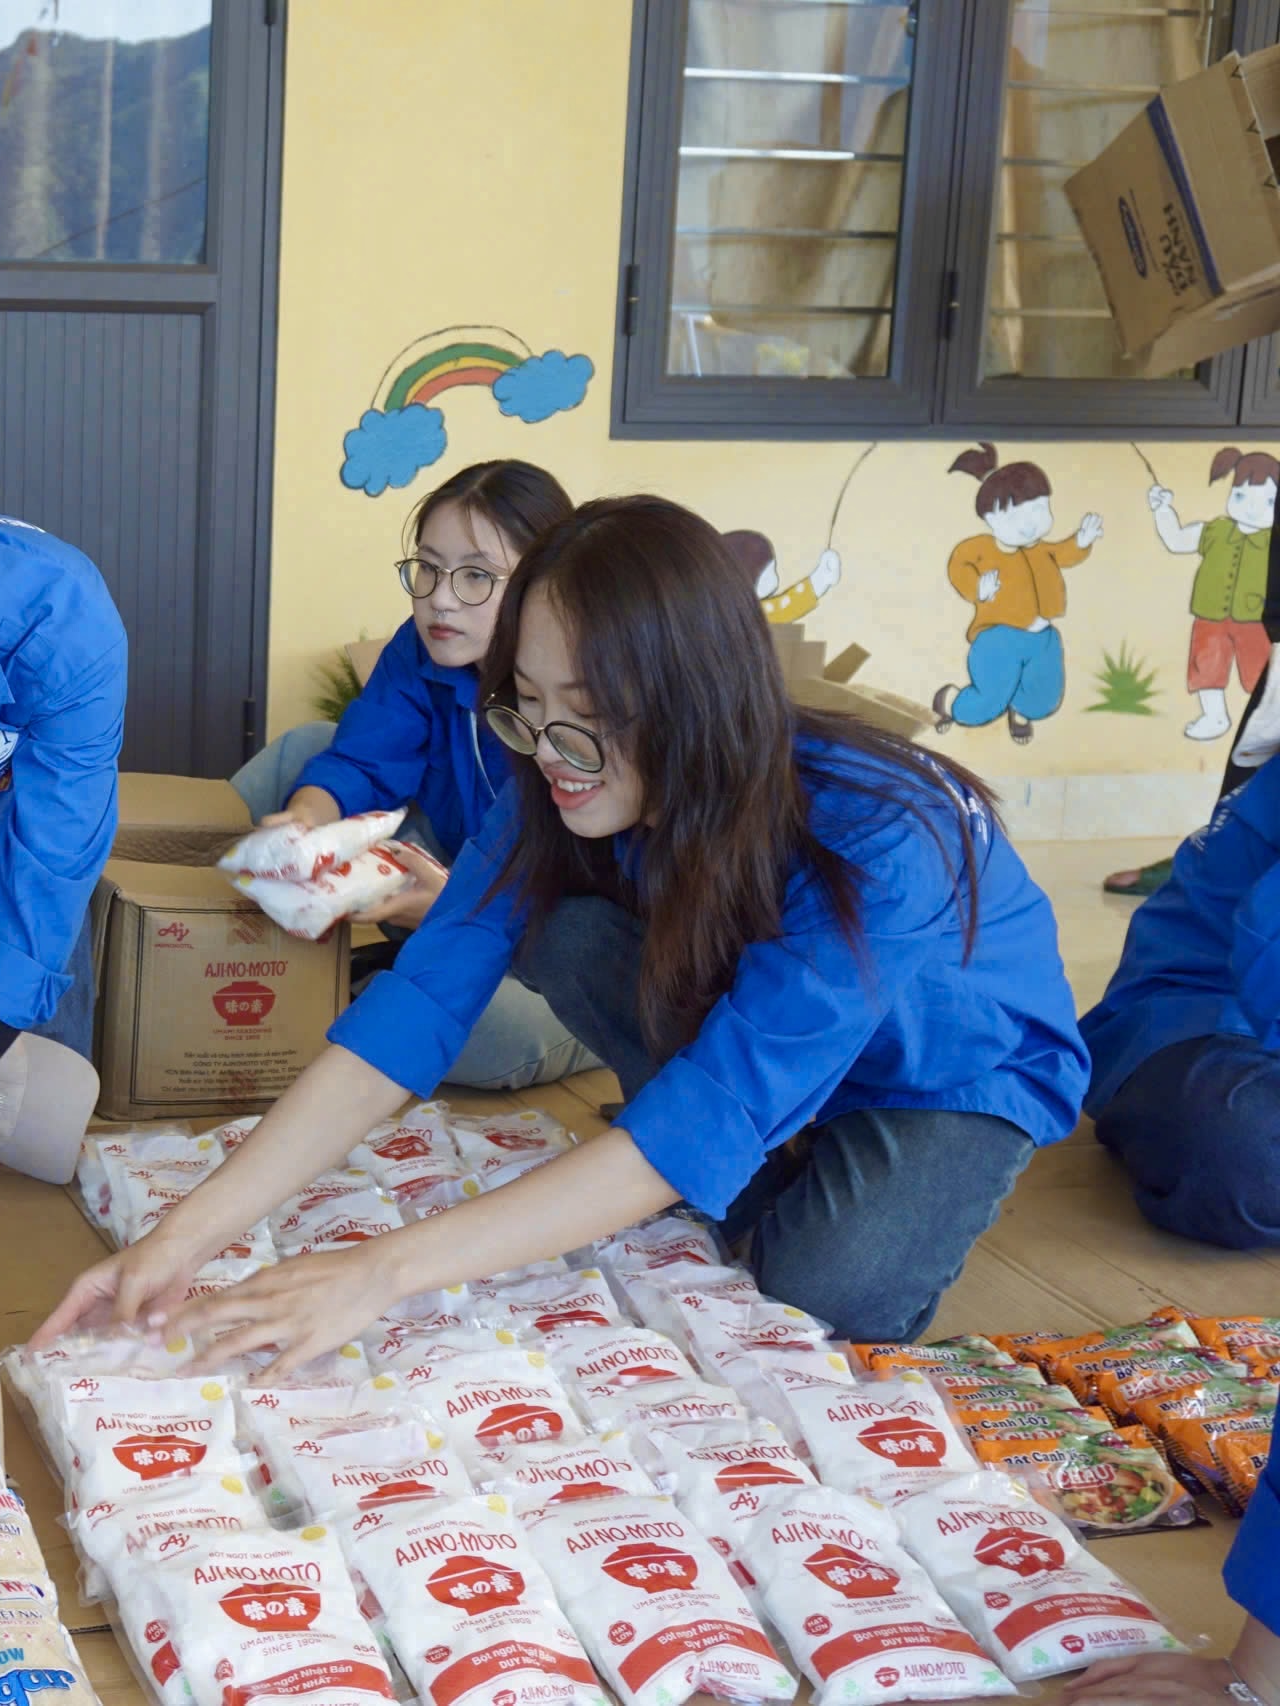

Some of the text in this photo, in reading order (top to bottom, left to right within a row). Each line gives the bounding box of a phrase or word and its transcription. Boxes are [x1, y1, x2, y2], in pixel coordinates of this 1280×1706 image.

[981, 1413, 1017, 1430] Canh
[1031, 1450, 1066, 1464] Canh
[625, 1559, 687, 1580] 味の素
[449, 1572, 514, 1600] 味の素
[242, 1596, 308, 1620] 味の素
[855, 1606, 885, 1615] SINCE
[452, 1617, 487, 1632] UMAMI
[476, 1623, 505, 1633] SINCE
[240, 1636, 275, 1650] UMAMI
[881, 1637, 903, 1647] DUY
[262, 1644, 292, 1656] SINCE
[499, 1657, 520, 1669] DUY
[278, 1684, 300, 1695] DUY
